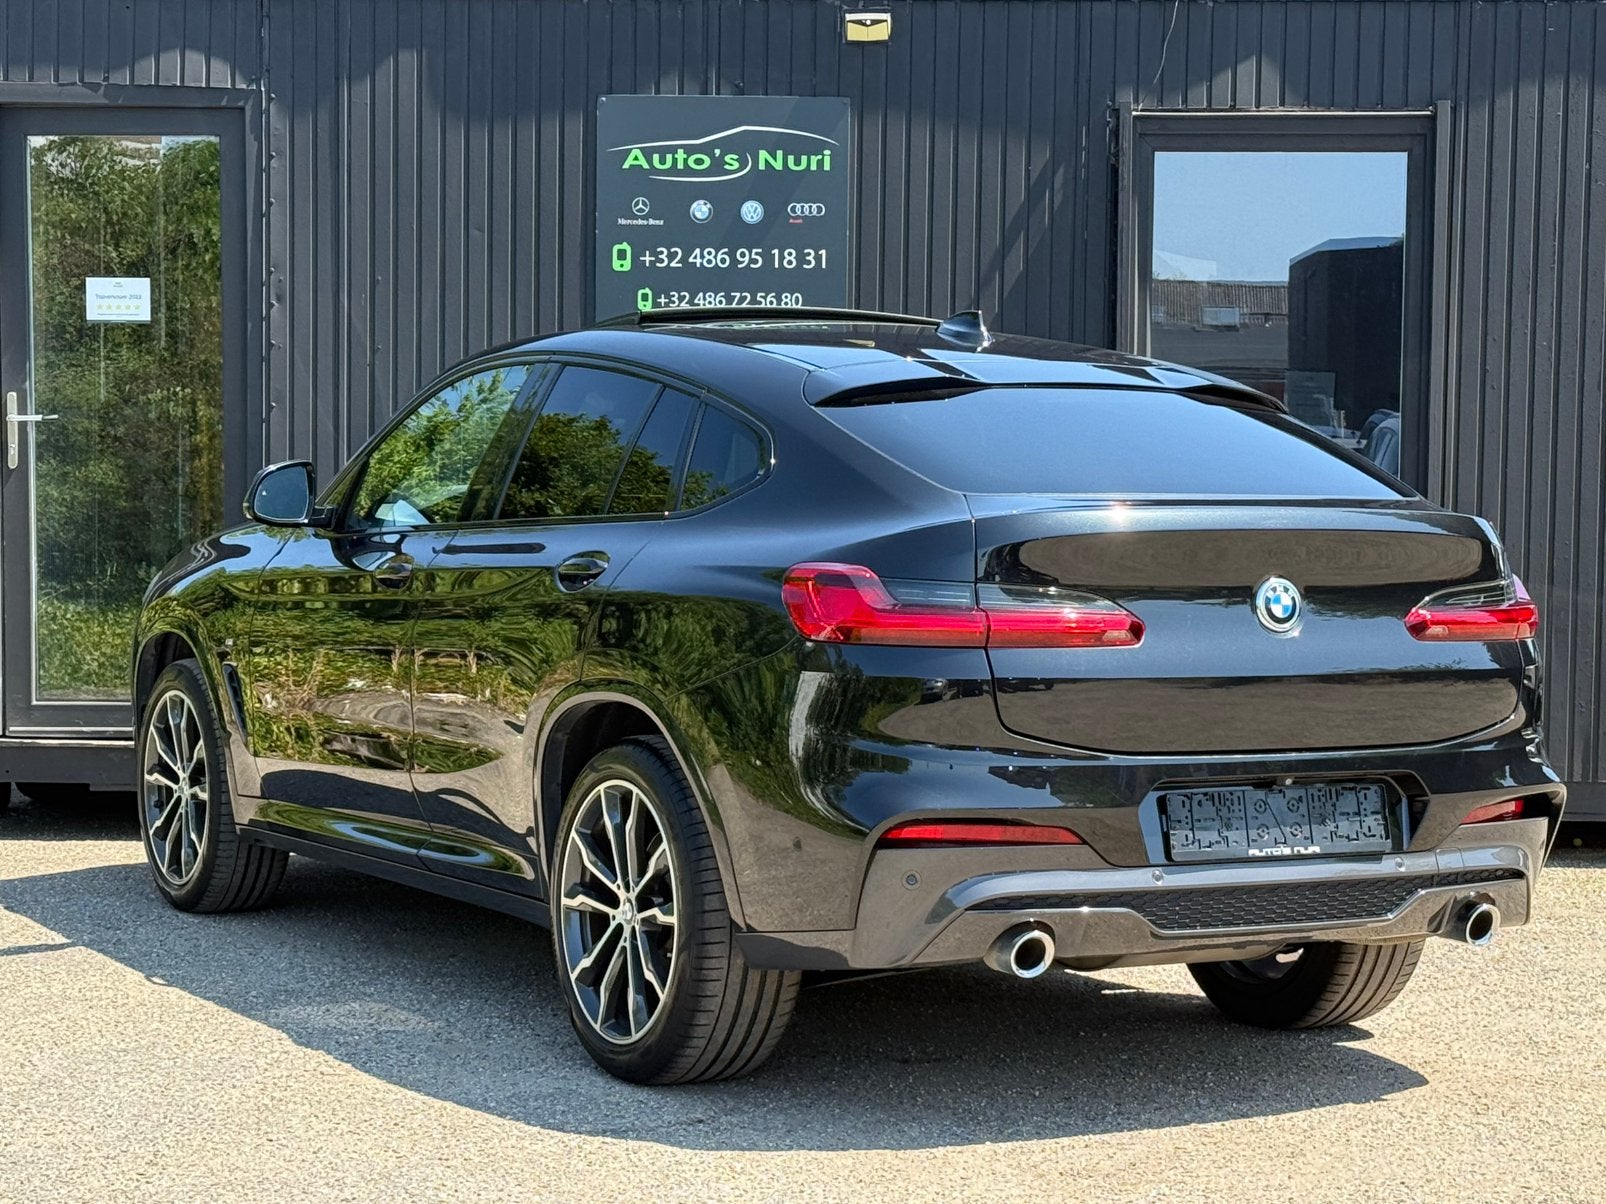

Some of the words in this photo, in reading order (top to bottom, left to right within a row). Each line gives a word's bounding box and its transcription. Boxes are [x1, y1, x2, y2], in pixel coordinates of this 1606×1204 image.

[621, 148, 740, 171] Auto's
[758, 149, 832, 171] Nuri
[617, 217, 665, 226] Mercedes-Benz
[639, 246, 683, 268] +32
[688, 247, 730, 268] 486
[736, 248, 763, 269] 95
[771, 248, 797, 269] 18
[802, 248, 827, 269] 31
[656, 291, 690, 307] +32
[693, 291, 727, 307] 486
[730, 292, 752, 307] 72
[756, 292, 777, 307] 56
[781, 292, 803, 307] 80
